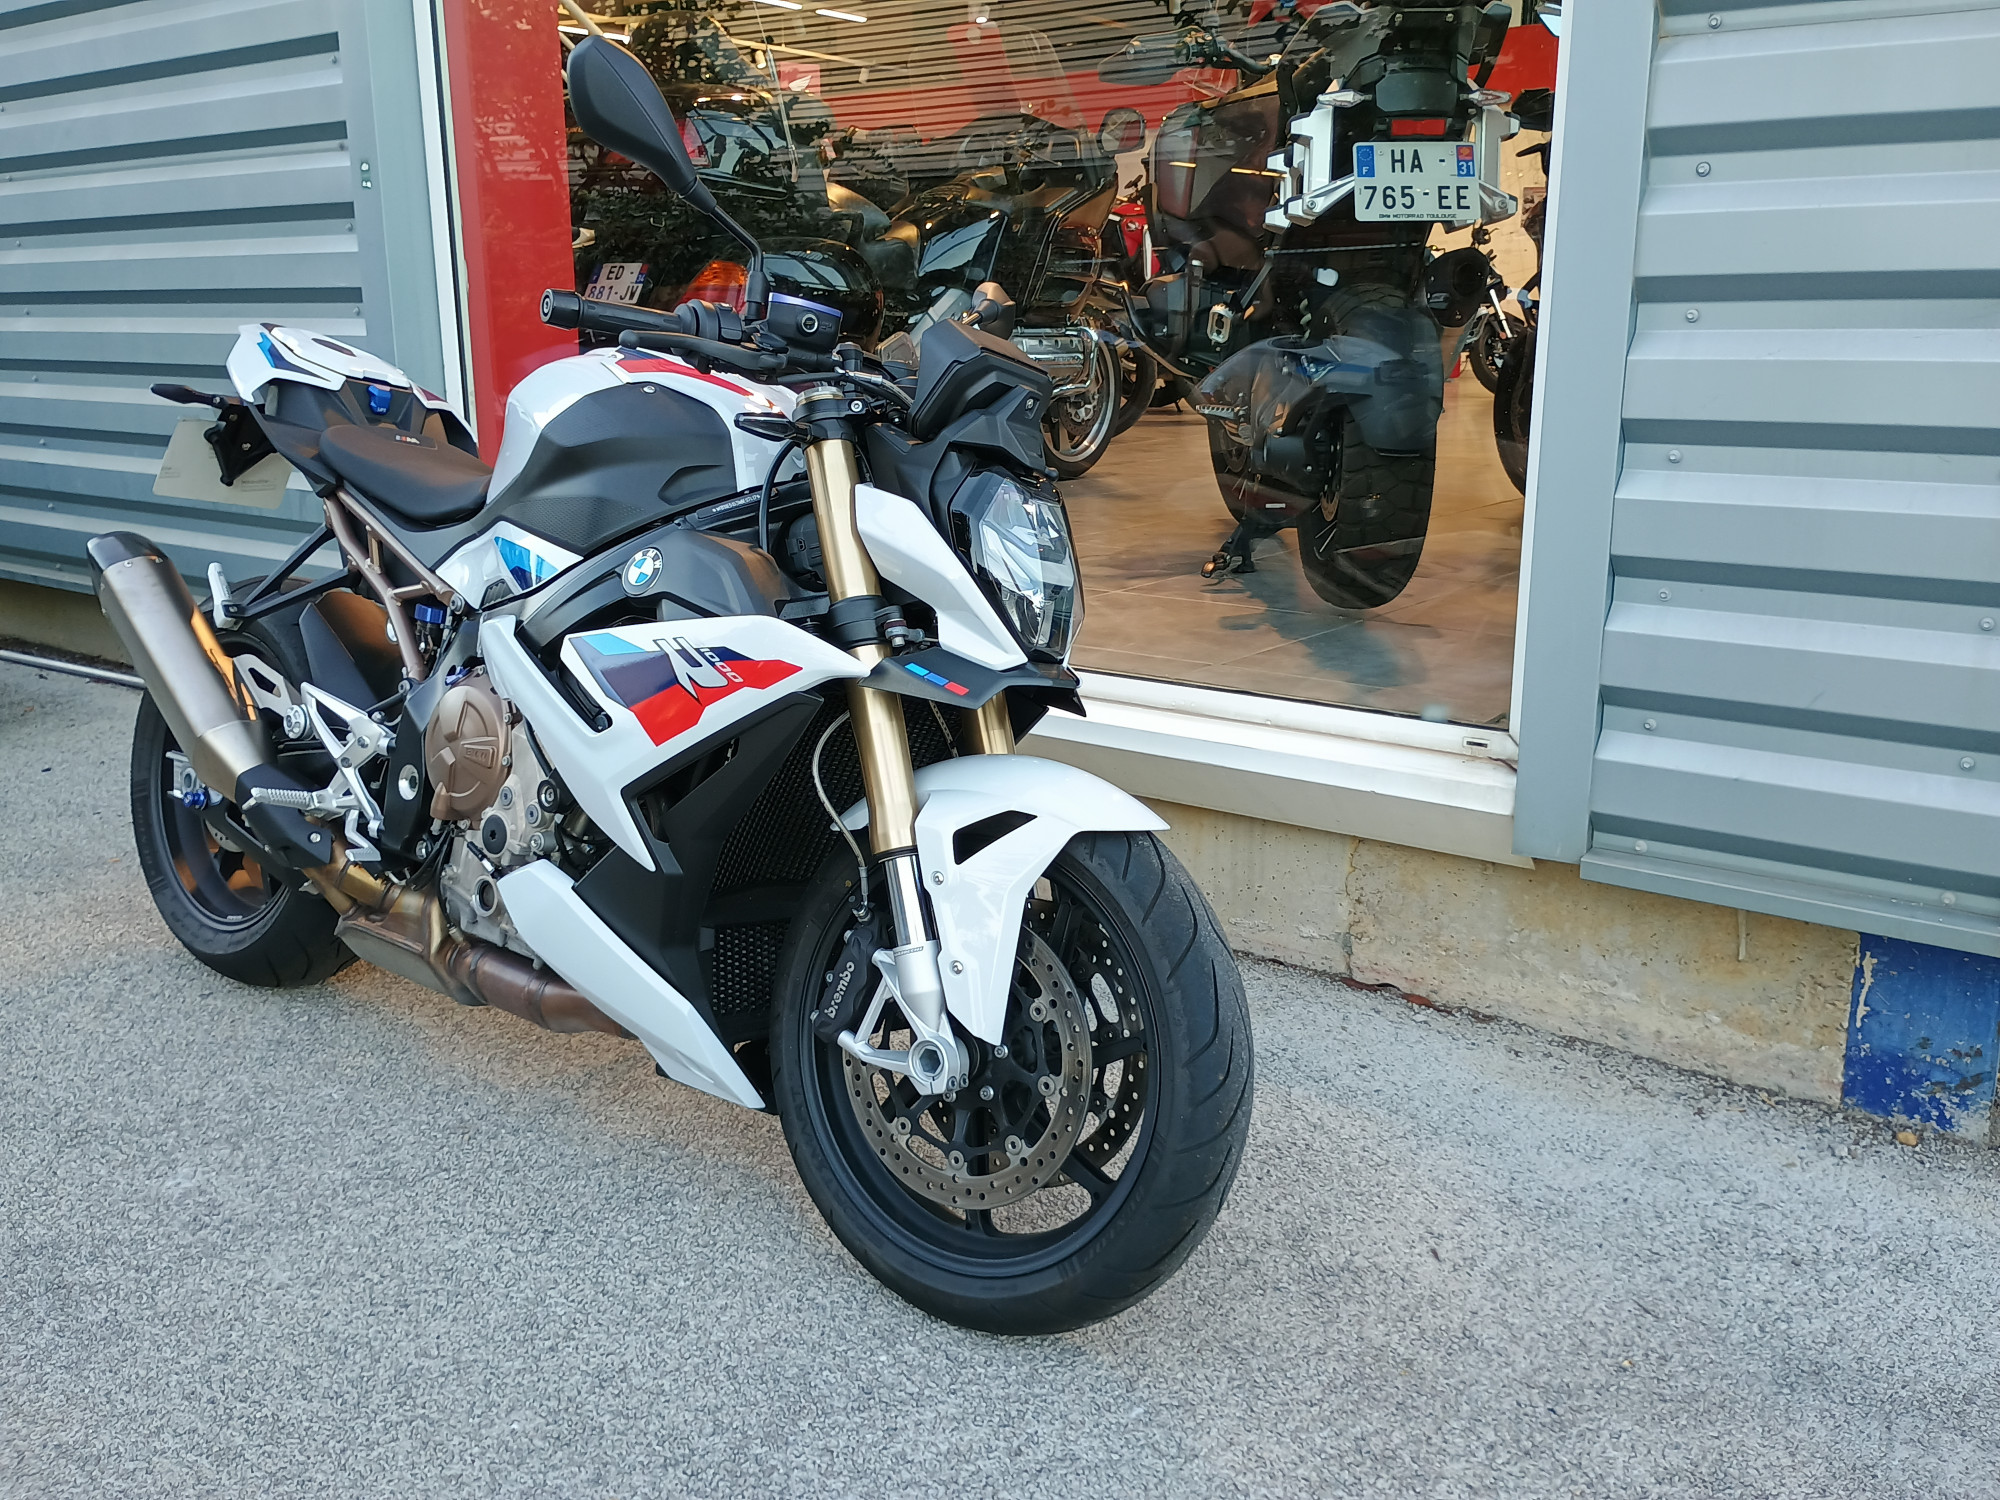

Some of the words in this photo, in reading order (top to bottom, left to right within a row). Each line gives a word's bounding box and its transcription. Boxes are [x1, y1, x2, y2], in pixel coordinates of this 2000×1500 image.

[1362, 166, 1370, 175] F
[1391, 149, 1423, 173] HA
[1459, 161, 1474, 175] 31
[606, 265, 625, 280] ED
[699, 648, 744, 683] 1000
[824, 961, 855, 1019] brembo
